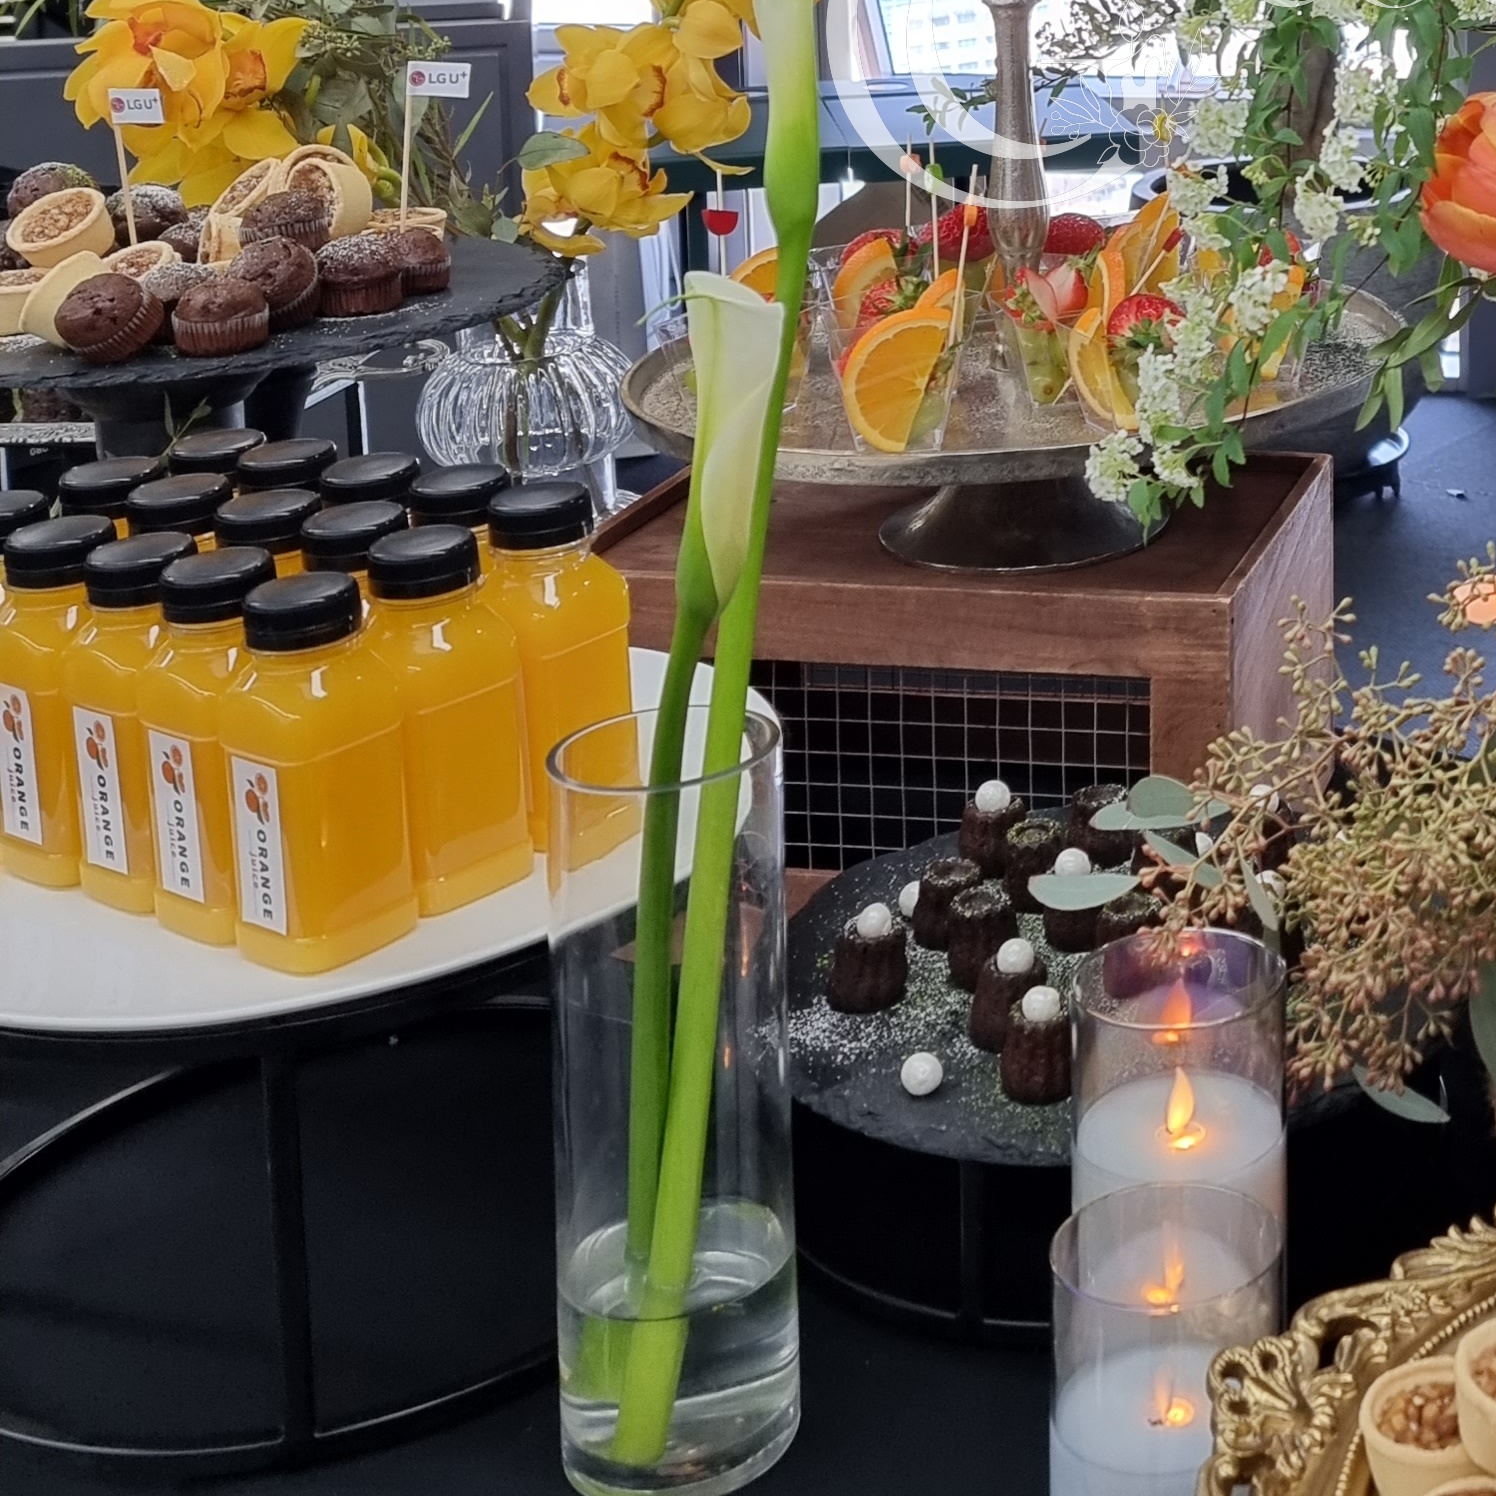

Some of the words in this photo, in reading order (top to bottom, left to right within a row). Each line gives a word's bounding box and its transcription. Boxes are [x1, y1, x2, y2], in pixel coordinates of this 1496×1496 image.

[13, 747, 29, 831] ORANGE
[97, 774, 115, 861] ORANGE
[173, 799, 190, 889] ORANGE
[257, 829, 273, 920] ORANGE
